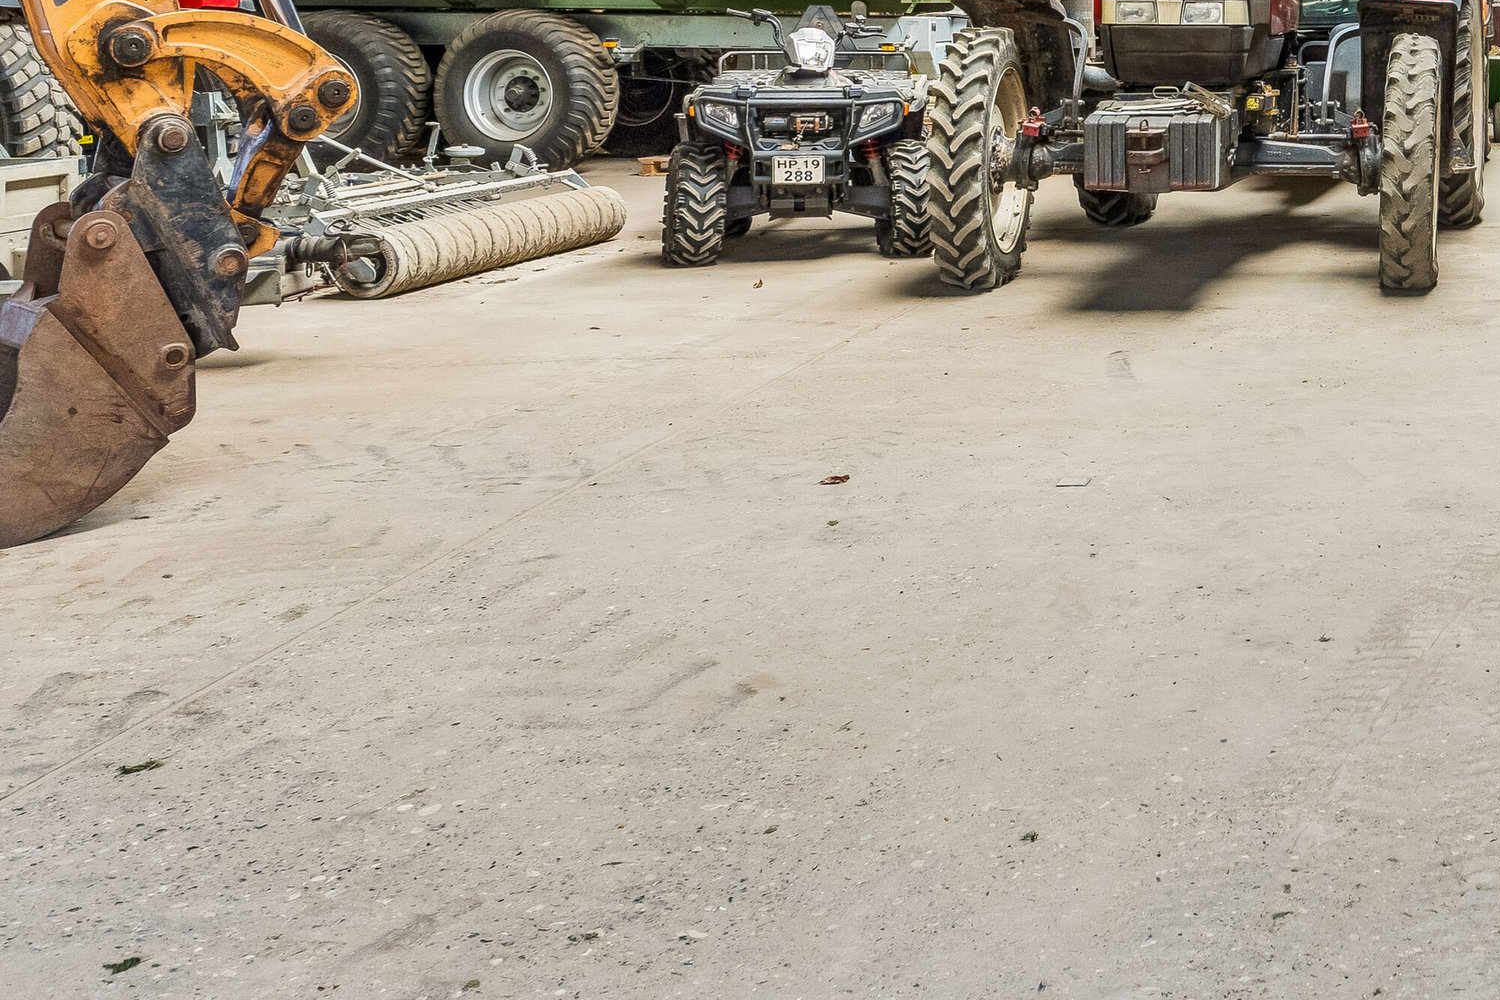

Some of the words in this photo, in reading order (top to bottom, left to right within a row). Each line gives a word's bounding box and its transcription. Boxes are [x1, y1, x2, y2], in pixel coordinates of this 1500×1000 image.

[777, 160, 798, 169] HP
[804, 160, 820, 169] 19
[784, 170, 813, 182] 288
